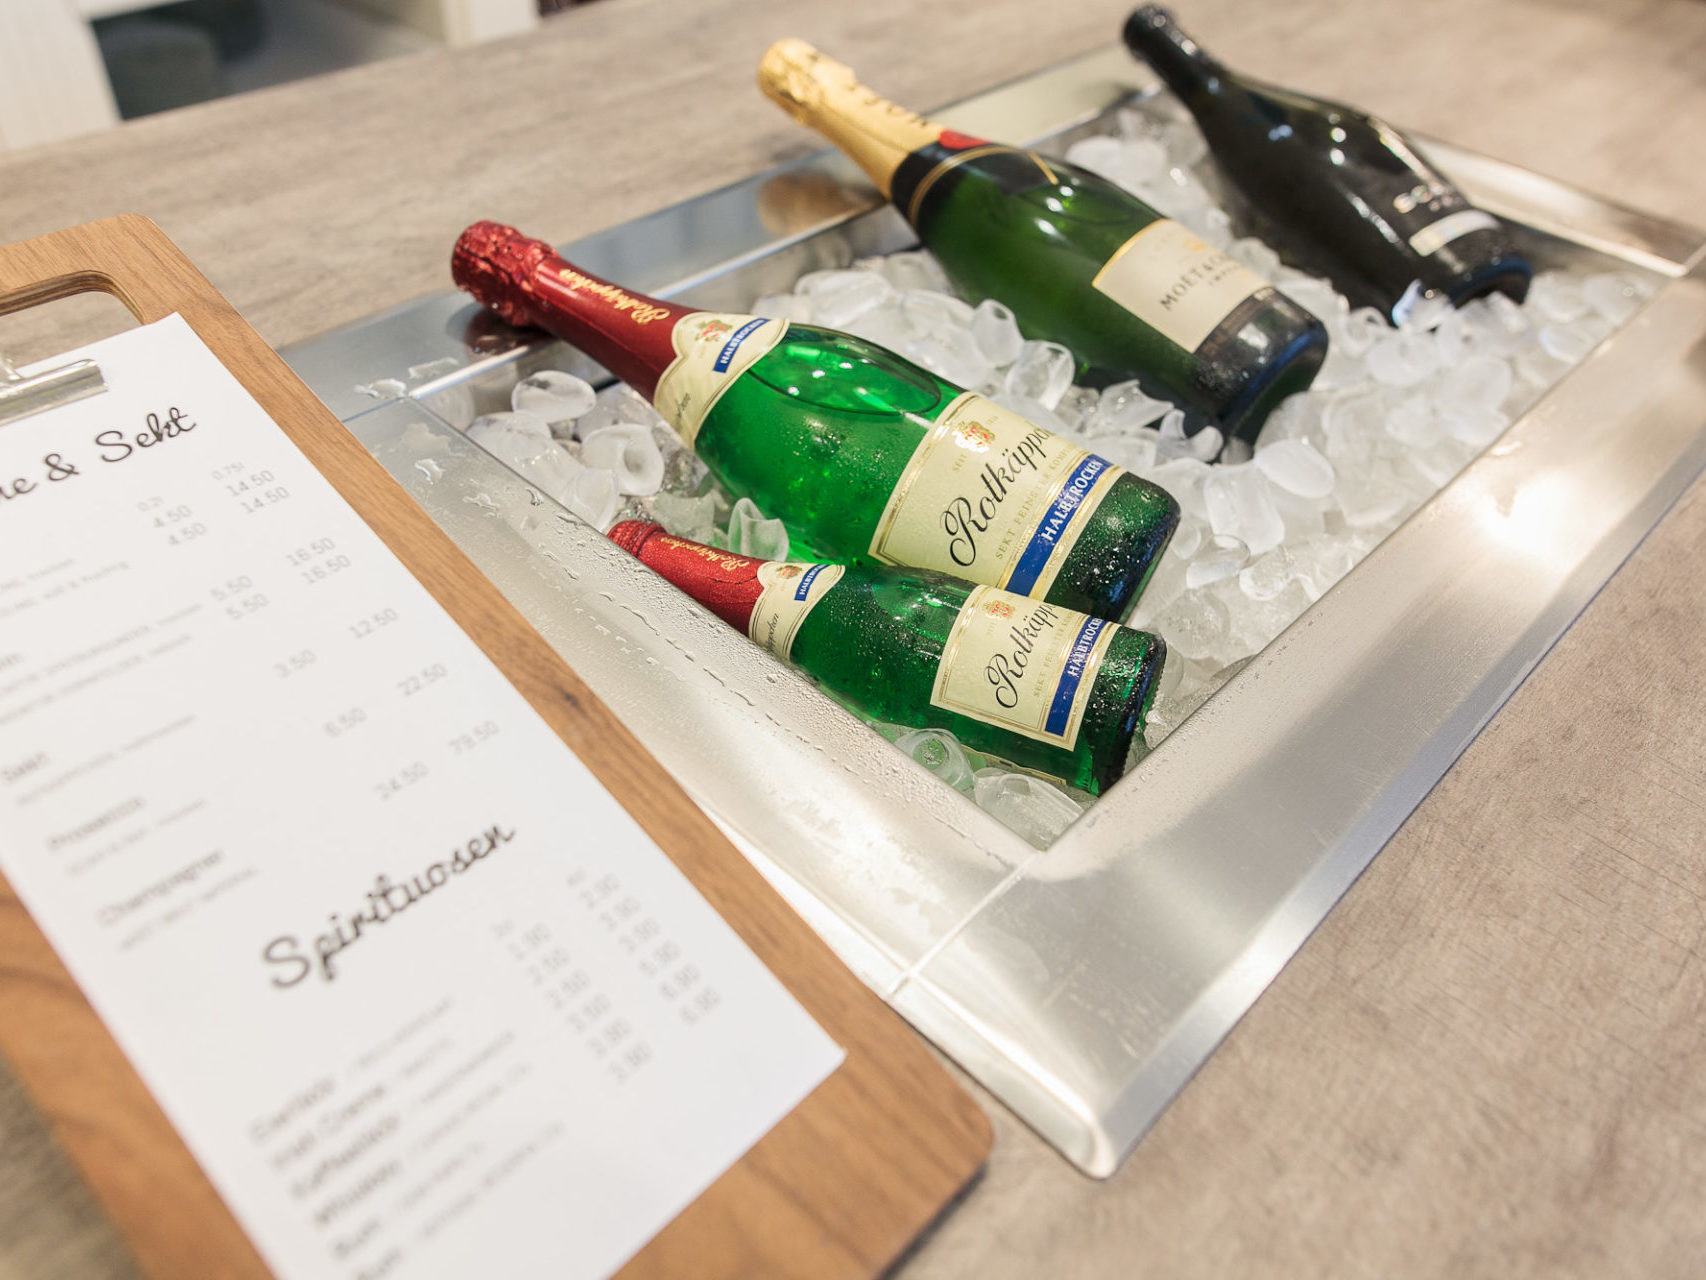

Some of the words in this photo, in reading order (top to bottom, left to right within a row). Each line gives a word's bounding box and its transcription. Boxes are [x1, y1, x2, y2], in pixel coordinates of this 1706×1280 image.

[0, 477, 39, 500] e
[44, 453, 80, 482] &
[94, 407, 197, 464] Sekt
[225, 469, 276, 498] 14.50
[240, 485, 292, 515] 14.50
[261, 822, 515, 990] Spirituosen
